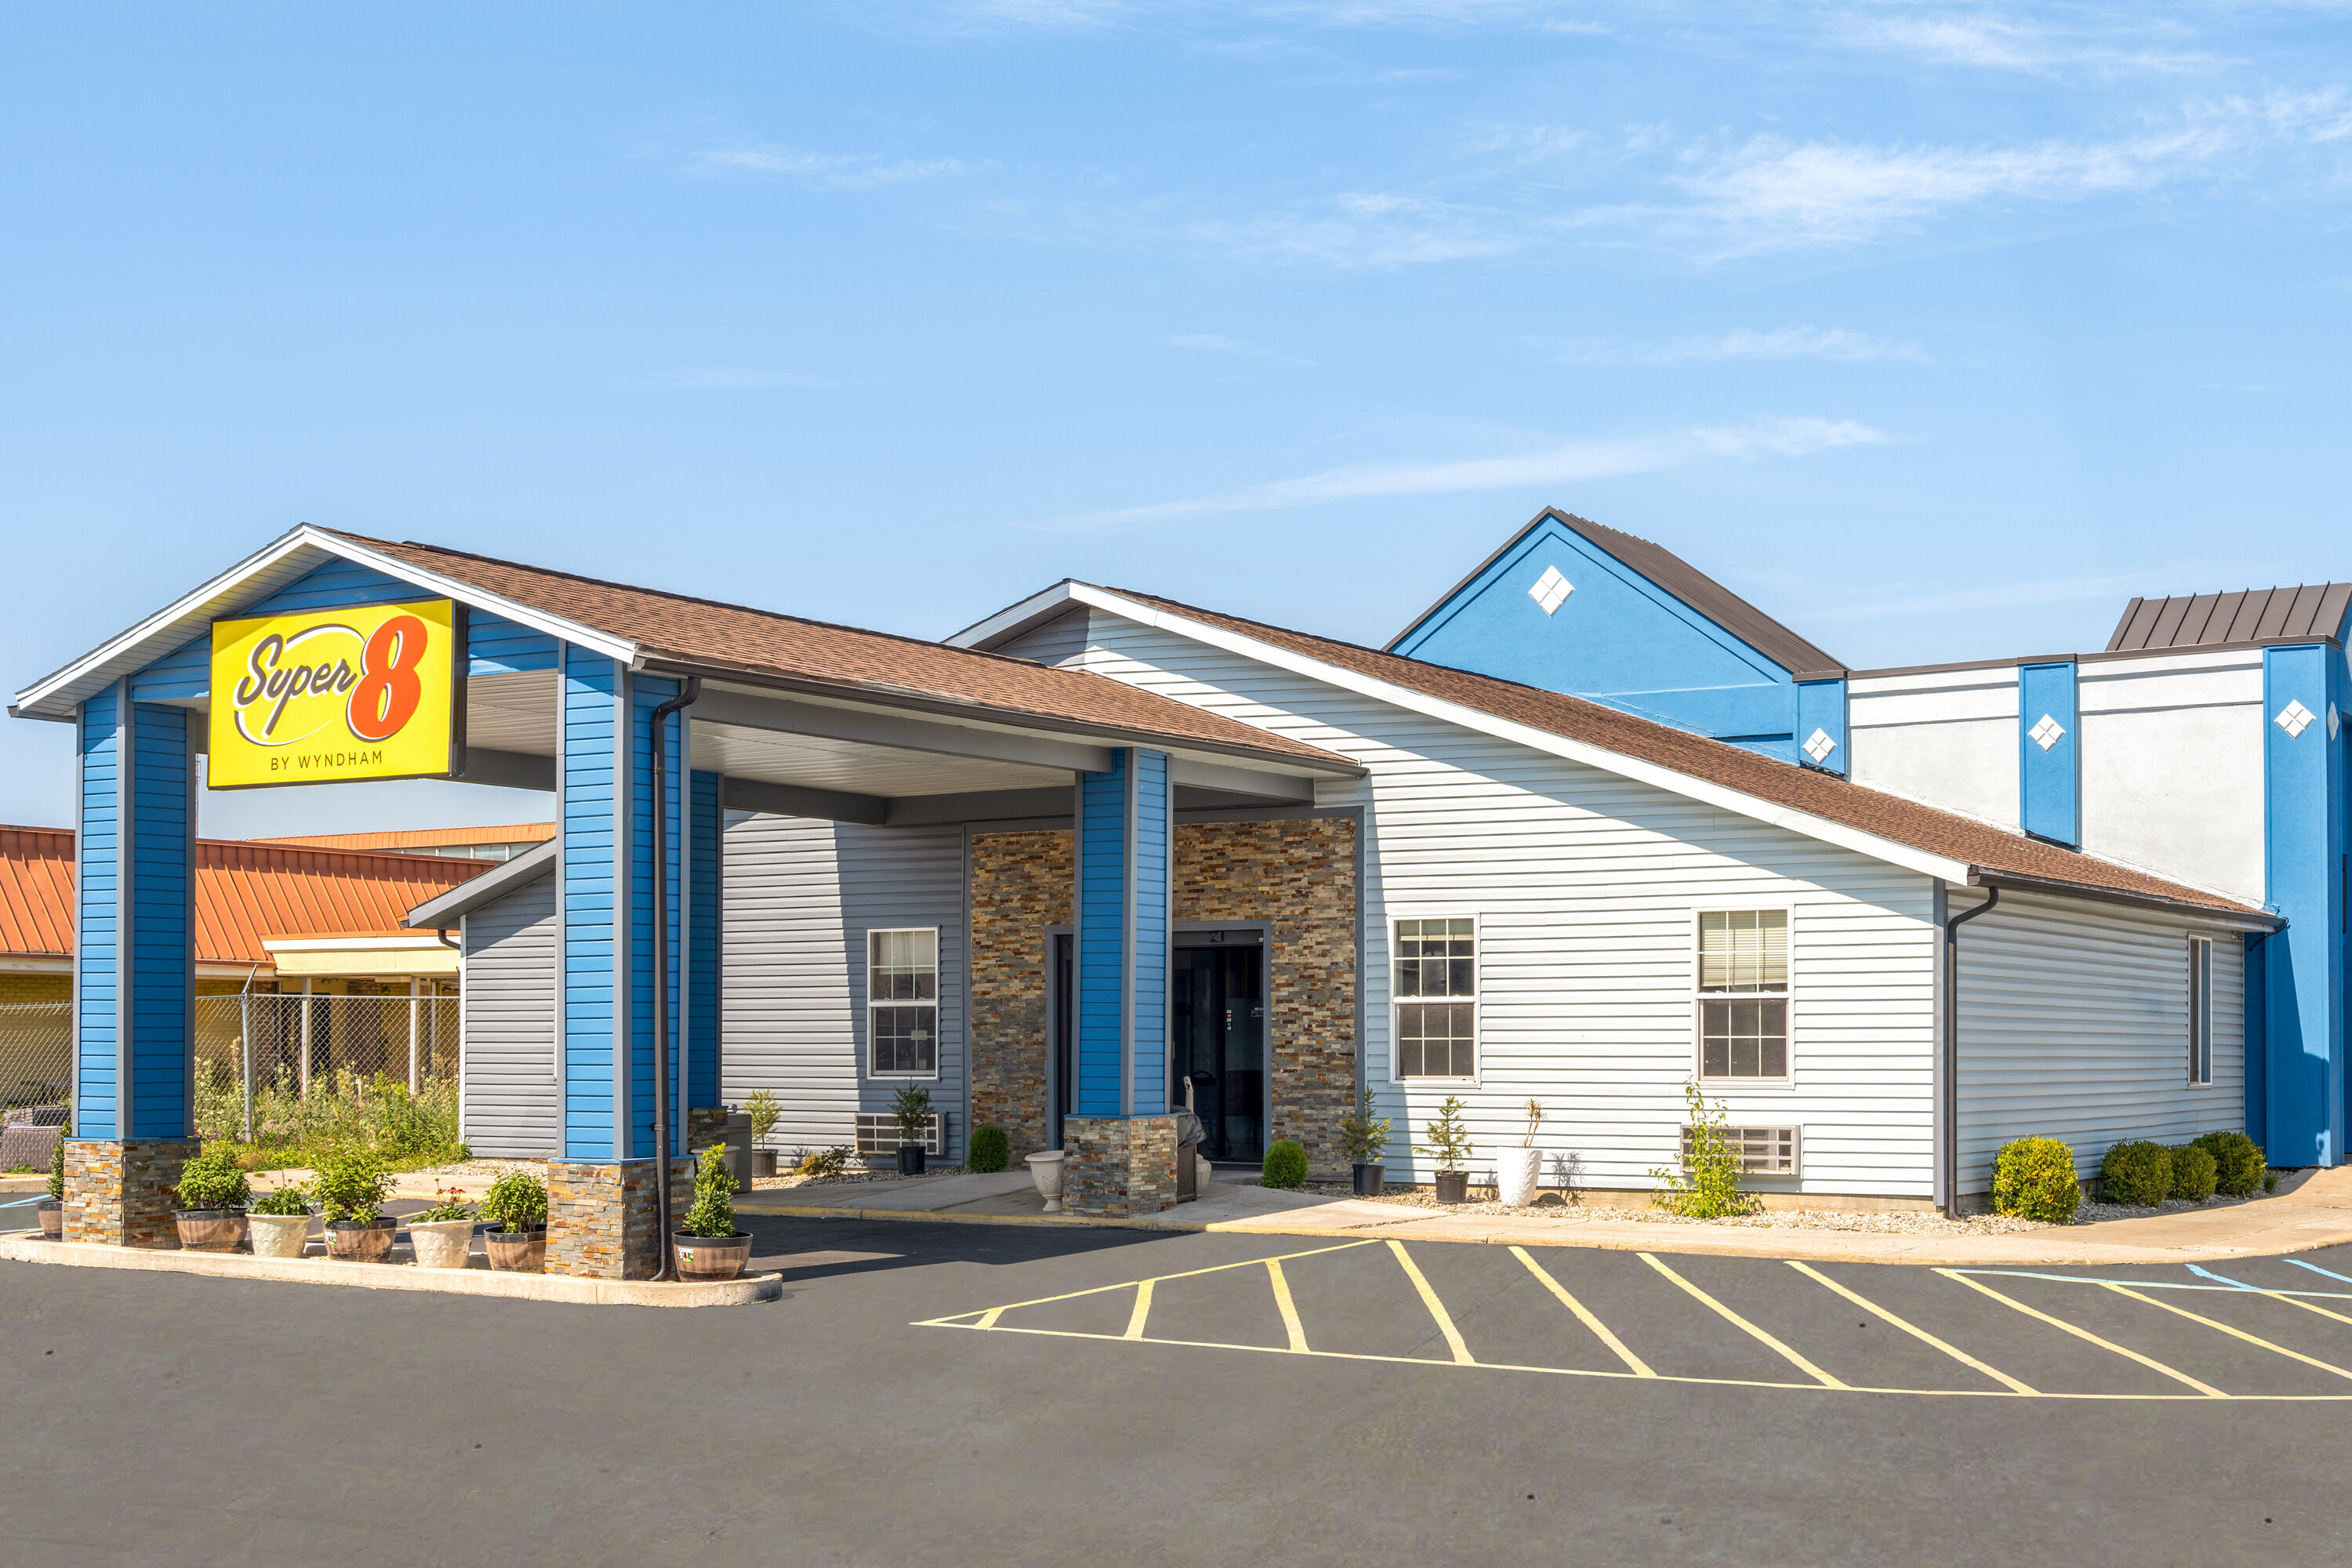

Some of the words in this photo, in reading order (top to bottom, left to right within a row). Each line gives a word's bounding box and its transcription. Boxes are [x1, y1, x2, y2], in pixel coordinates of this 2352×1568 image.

[234, 633, 357, 738] Super
[347, 615, 428, 742] 8
[270, 757, 289, 771] BY
[298, 750, 382, 769] WYNDHAM
